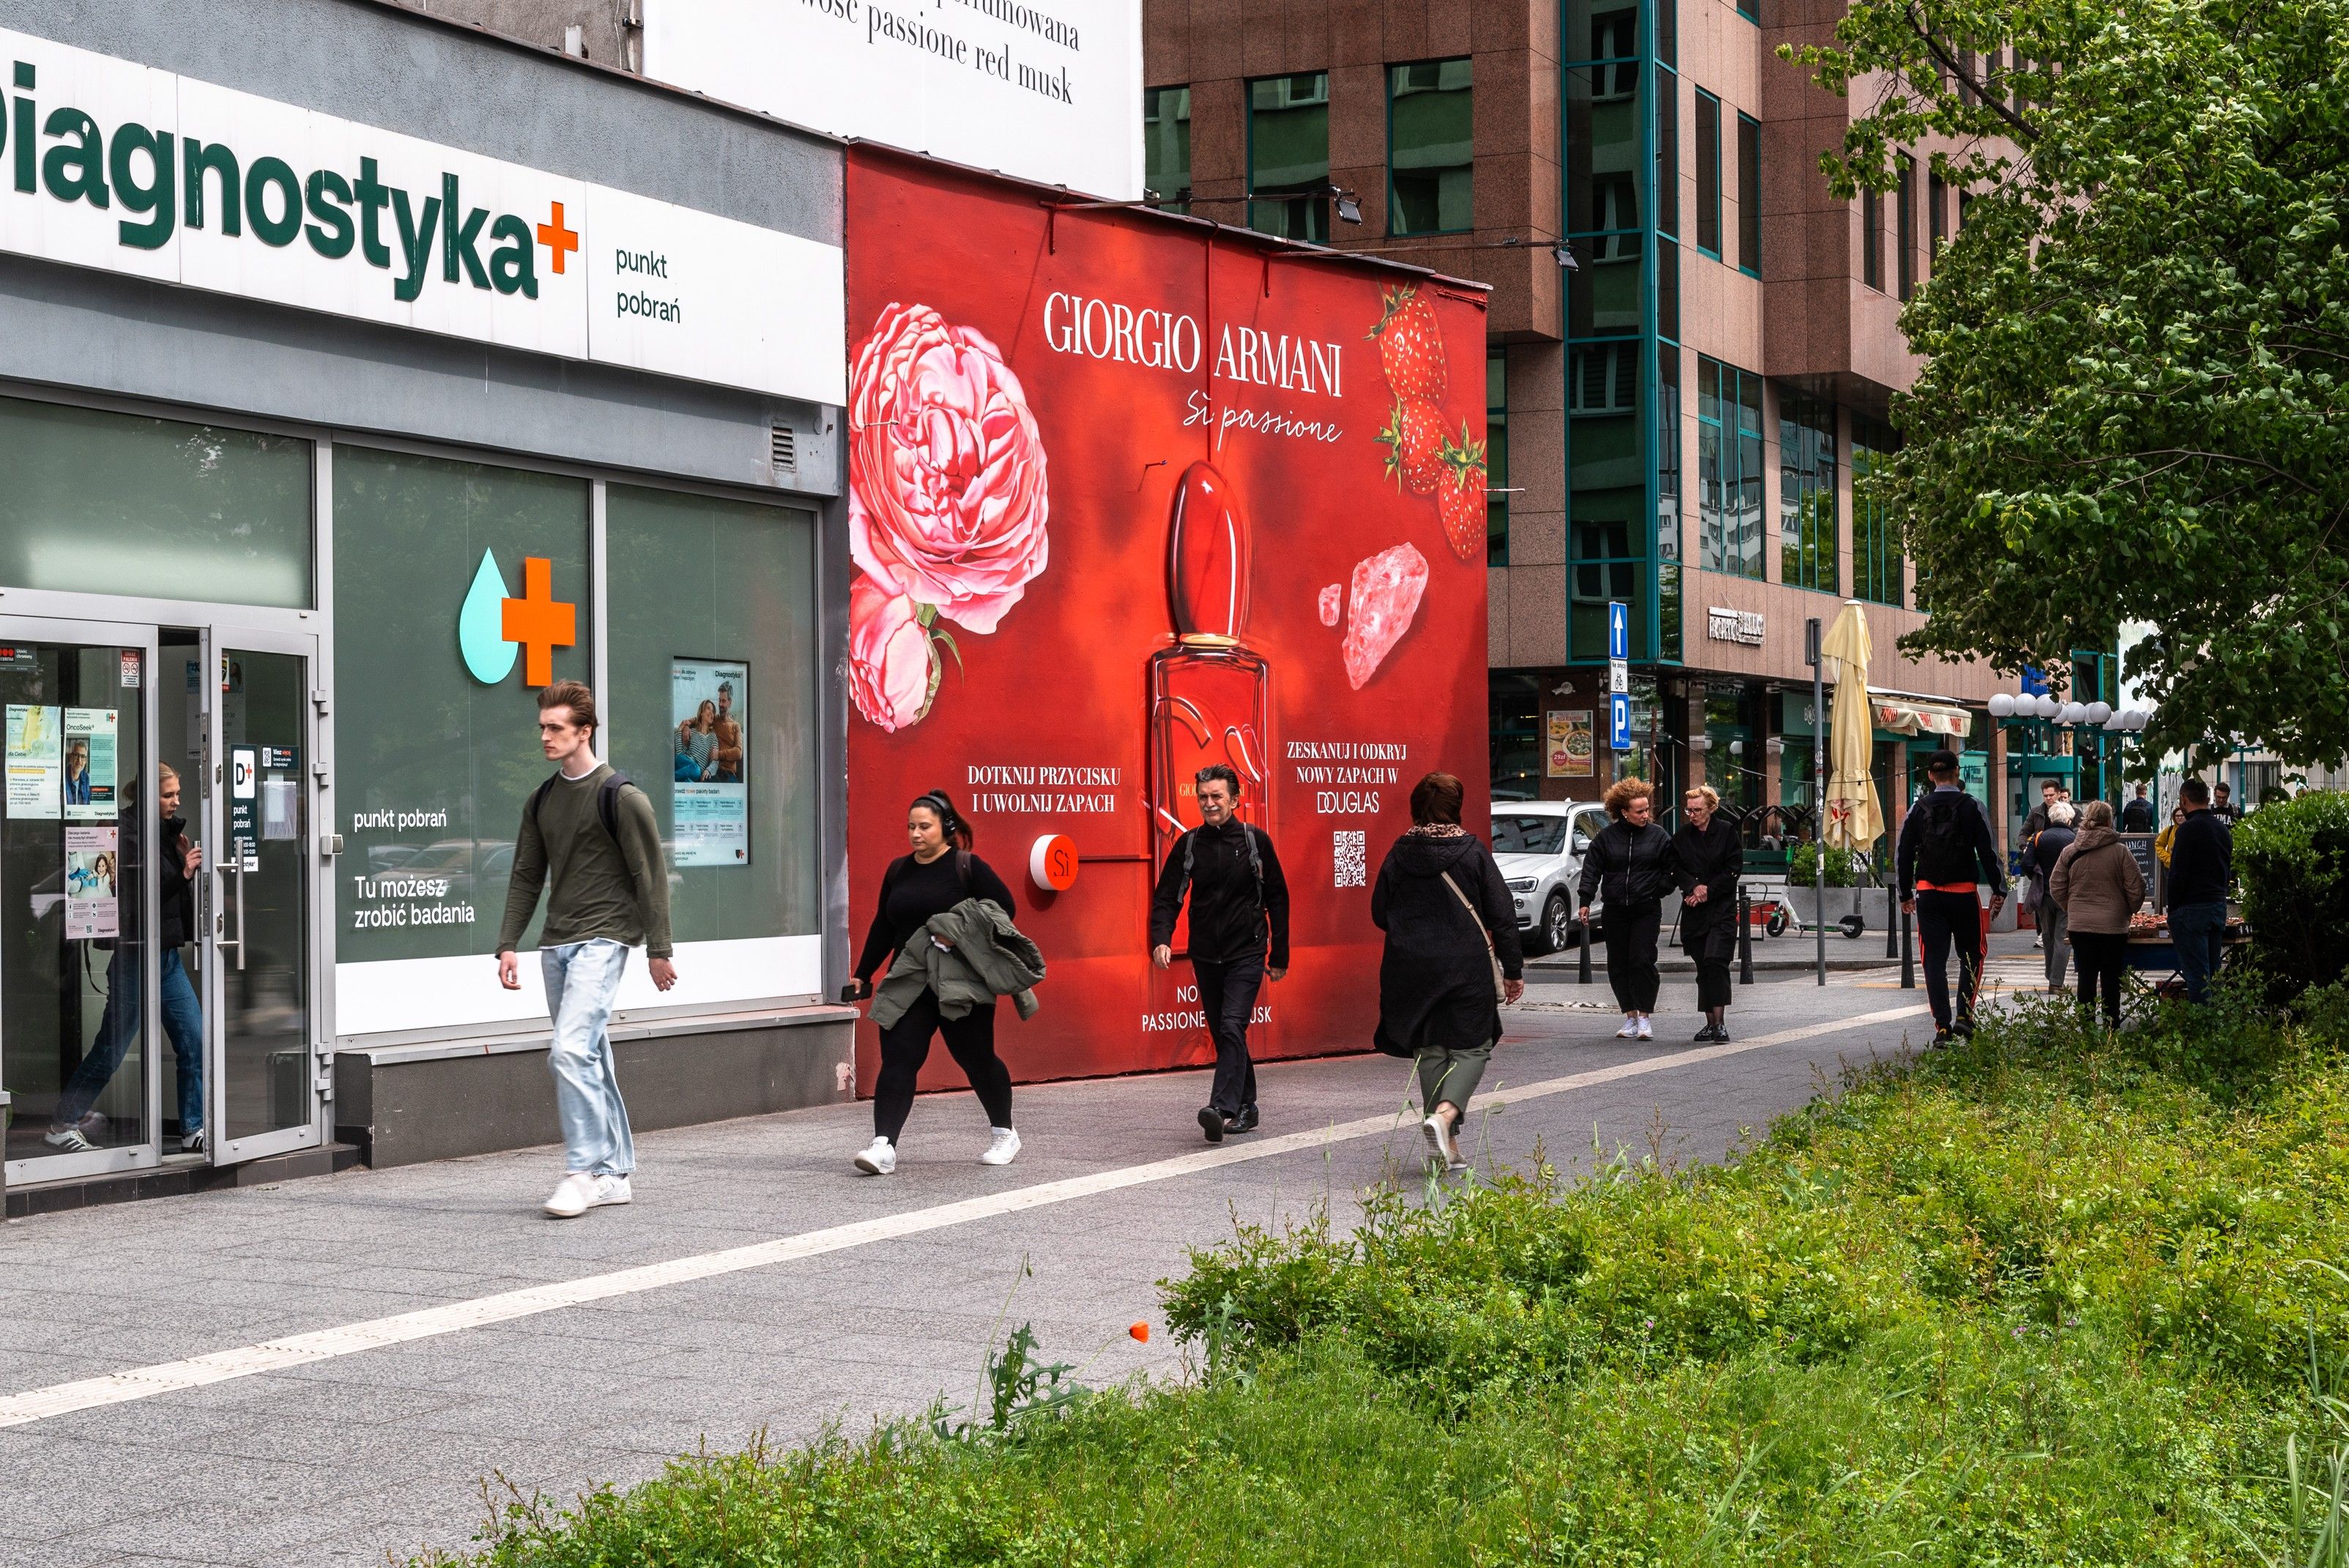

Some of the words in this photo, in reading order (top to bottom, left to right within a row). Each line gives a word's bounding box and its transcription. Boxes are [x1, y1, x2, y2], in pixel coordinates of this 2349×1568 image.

[867, 4, 967, 64] passione
[975, 43, 1011, 82] red
[1018, 65, 1073, 105] musk
[616, 248, 667, 279] punkt
[617, 290, 680, 324] pobrań
[1043, 291, 1201, 374] GIORGIO
[1213, 322, 1343, 398] ARMANI
[1217, 405, 1343, 452] passione
[1615, 699, 1626, 743] P
[1287, 741, 1351, 759] ZESKANUJ
[1353, 743, 1358, 759] I
[1360, 743, 1407, 761] ODKRYJ
[968, 765, 1036, 786] DOTKNIJ
[1039, 767, 1121, 787] PRZYCISKU
[1296, 766, 1335, 784] NOWY
[1336, 767, 1384, 784] ZAPACH
[1387, 768, 1400, 784] W
[233, 805, 248, 817] punkt
[972, 793, 979, 812] I
[982, 793, 1053, 813] UWOLNIJ
[1055, 793, 1115, 813] ZAPACH
[1317, 791, 1380, 814] DOUGLAS
[233, 818, 251, 831] pobrań
[354, 808, 395, 833] punkt
[398, 808, 447, 833] pobrań
[2126, 840, 2147, 849] UNCH
[355, 876, 376, 899] Tu
[381, 874, 446, 898] możesz
[355, 902, 407, 928] zrobić
[411, 900, 475, 926] badania
[1141, 1010, 1206, 1032] PASSIONE
[1250, 1006, 1272, 1025] USK
